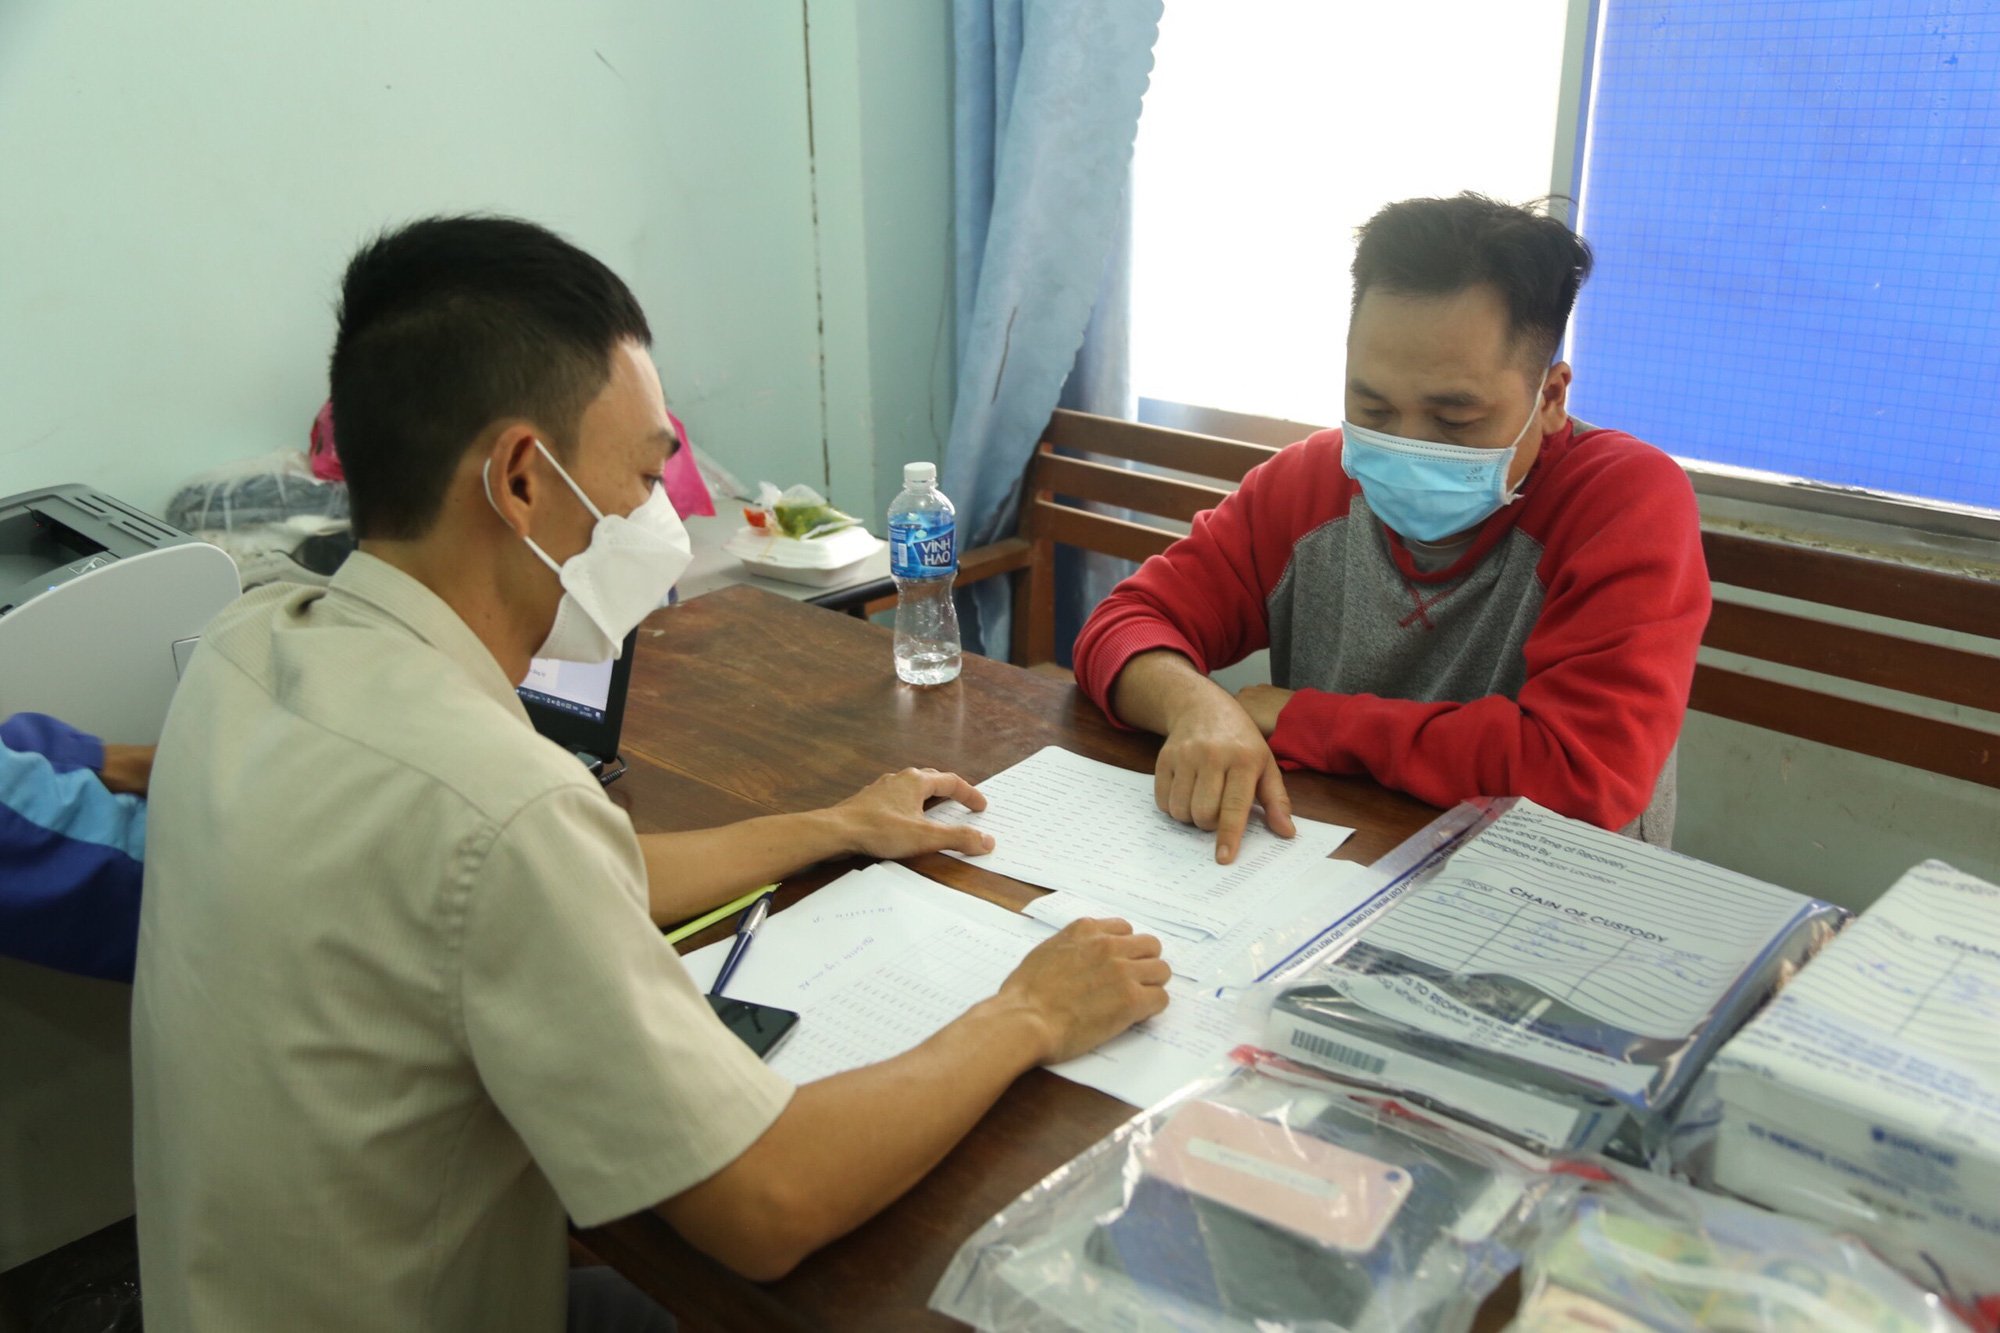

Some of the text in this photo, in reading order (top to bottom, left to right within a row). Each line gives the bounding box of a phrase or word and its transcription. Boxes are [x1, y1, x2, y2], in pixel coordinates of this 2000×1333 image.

[1509, 886, 1562, 910] CHAIN
[1564, 908, 1589, 919] OF
[1590, 915, 1669, 944] CUSTODY
